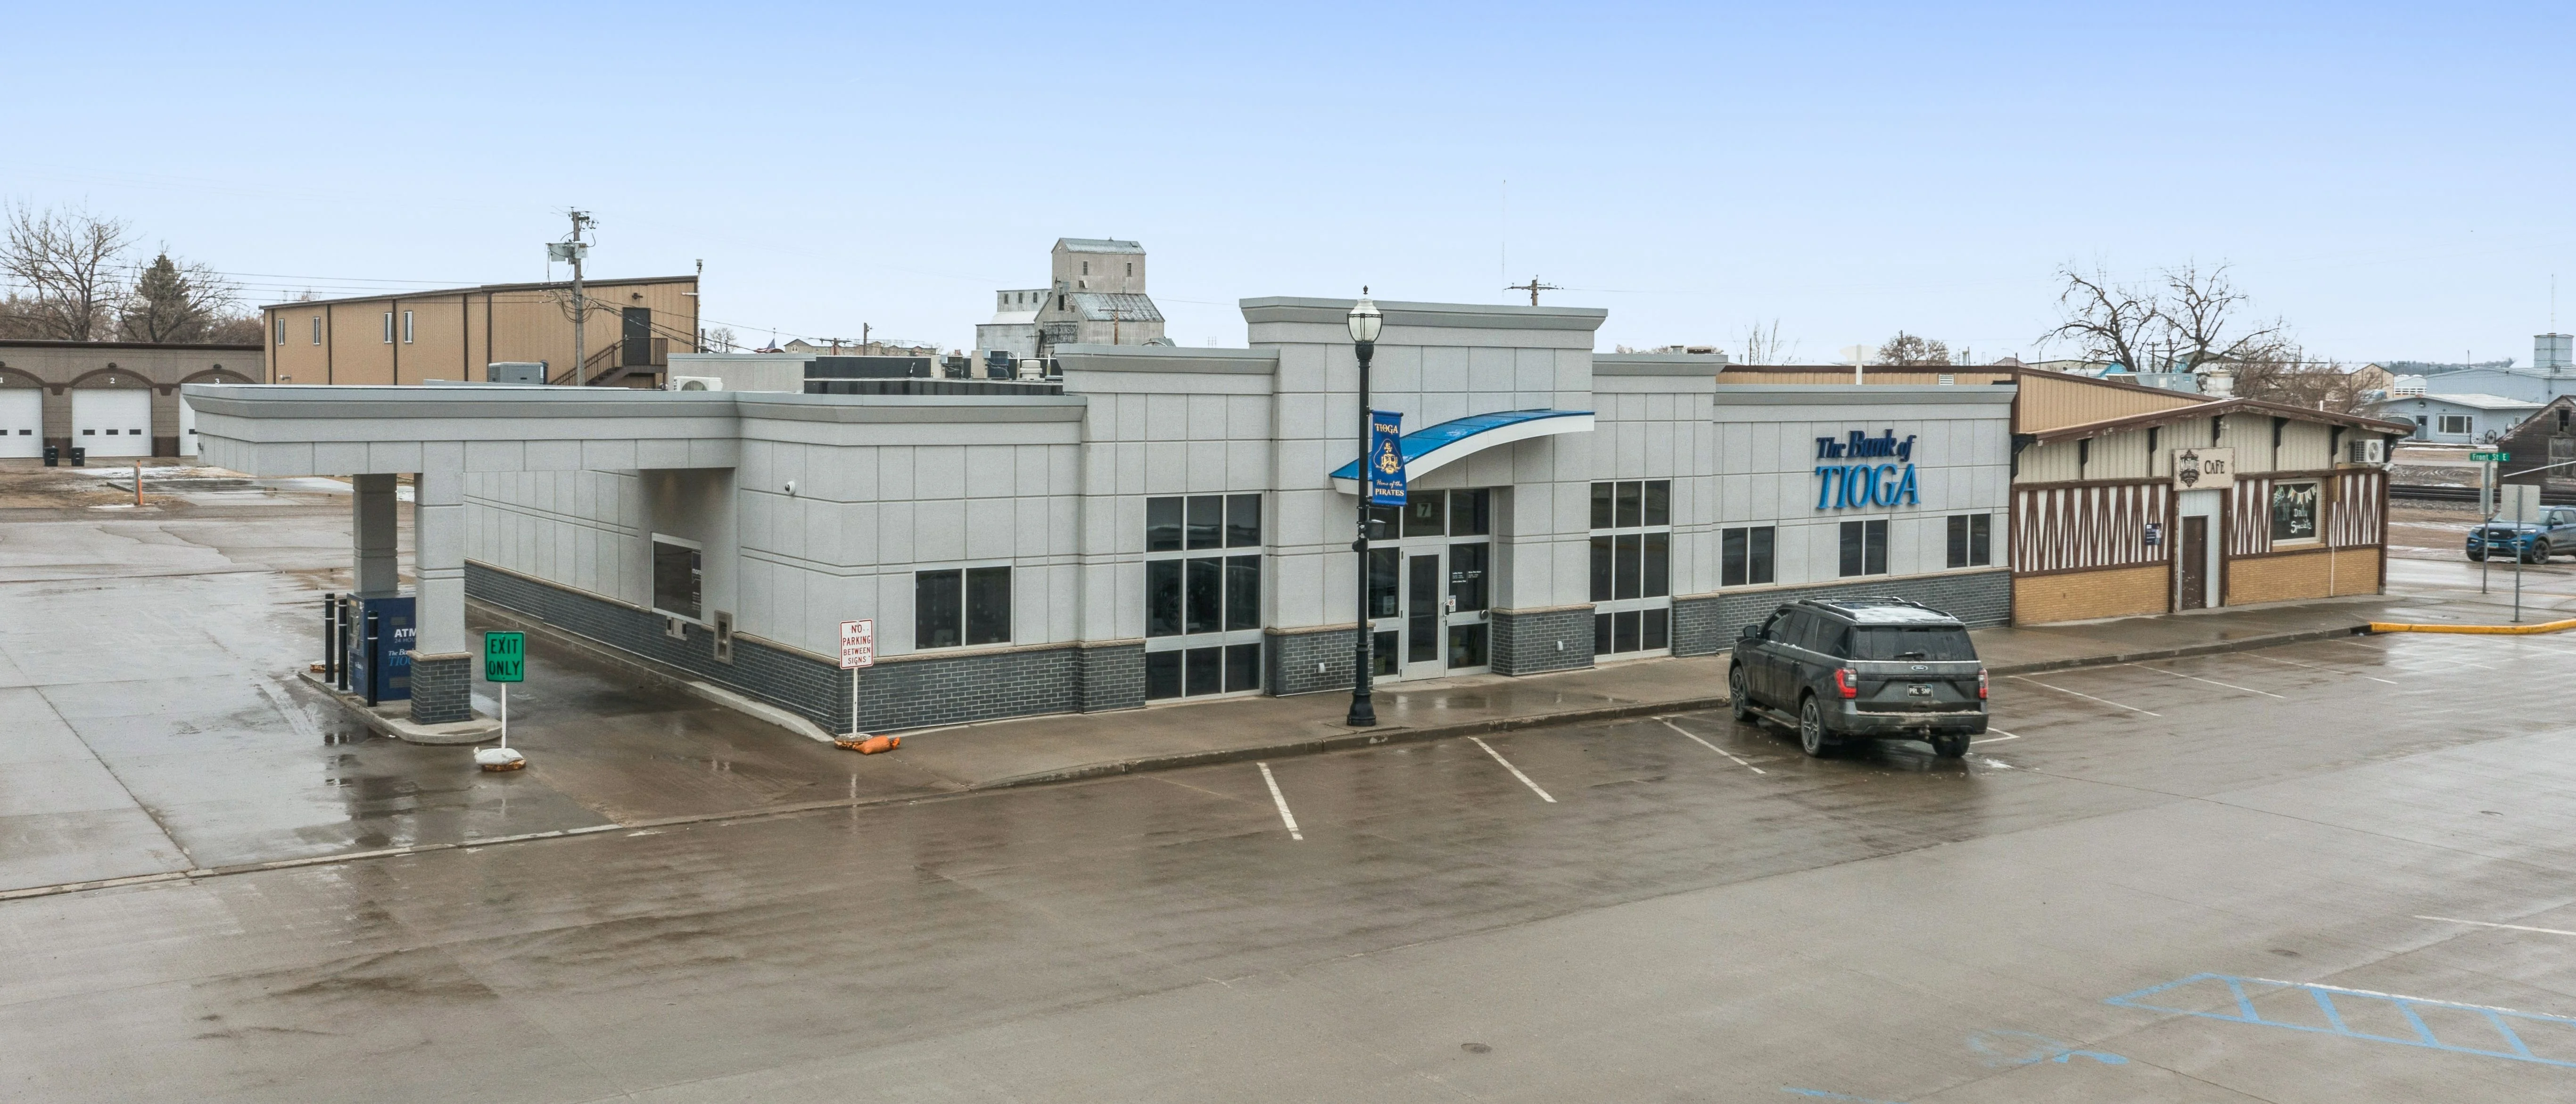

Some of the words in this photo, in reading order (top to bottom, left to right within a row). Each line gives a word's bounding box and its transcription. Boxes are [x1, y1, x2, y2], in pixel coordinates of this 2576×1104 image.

[1375, 423, 1398, 435] TIOGA
[1816, 437, 1847, 458] The
[1846, 429, 1897, 458] Bank
[1897, 435, 1917, 462] of
[1389, 481, 1395, 489] of
[1815, 463, 1921, 509] TIOGA
[1375, 488, 1404, 496] PIRATES
[1421, 504, 1428, 517] 7
[851, 625, 862, 634] NO
[491, 638, 518, 654] EXIT
[843, 635, 871, 646] PARKING
[843, 647, 870, 656] BETWEEN
[848, 656, 866, 664] SIGNS
[489, 660, 520, 675] ONLY
